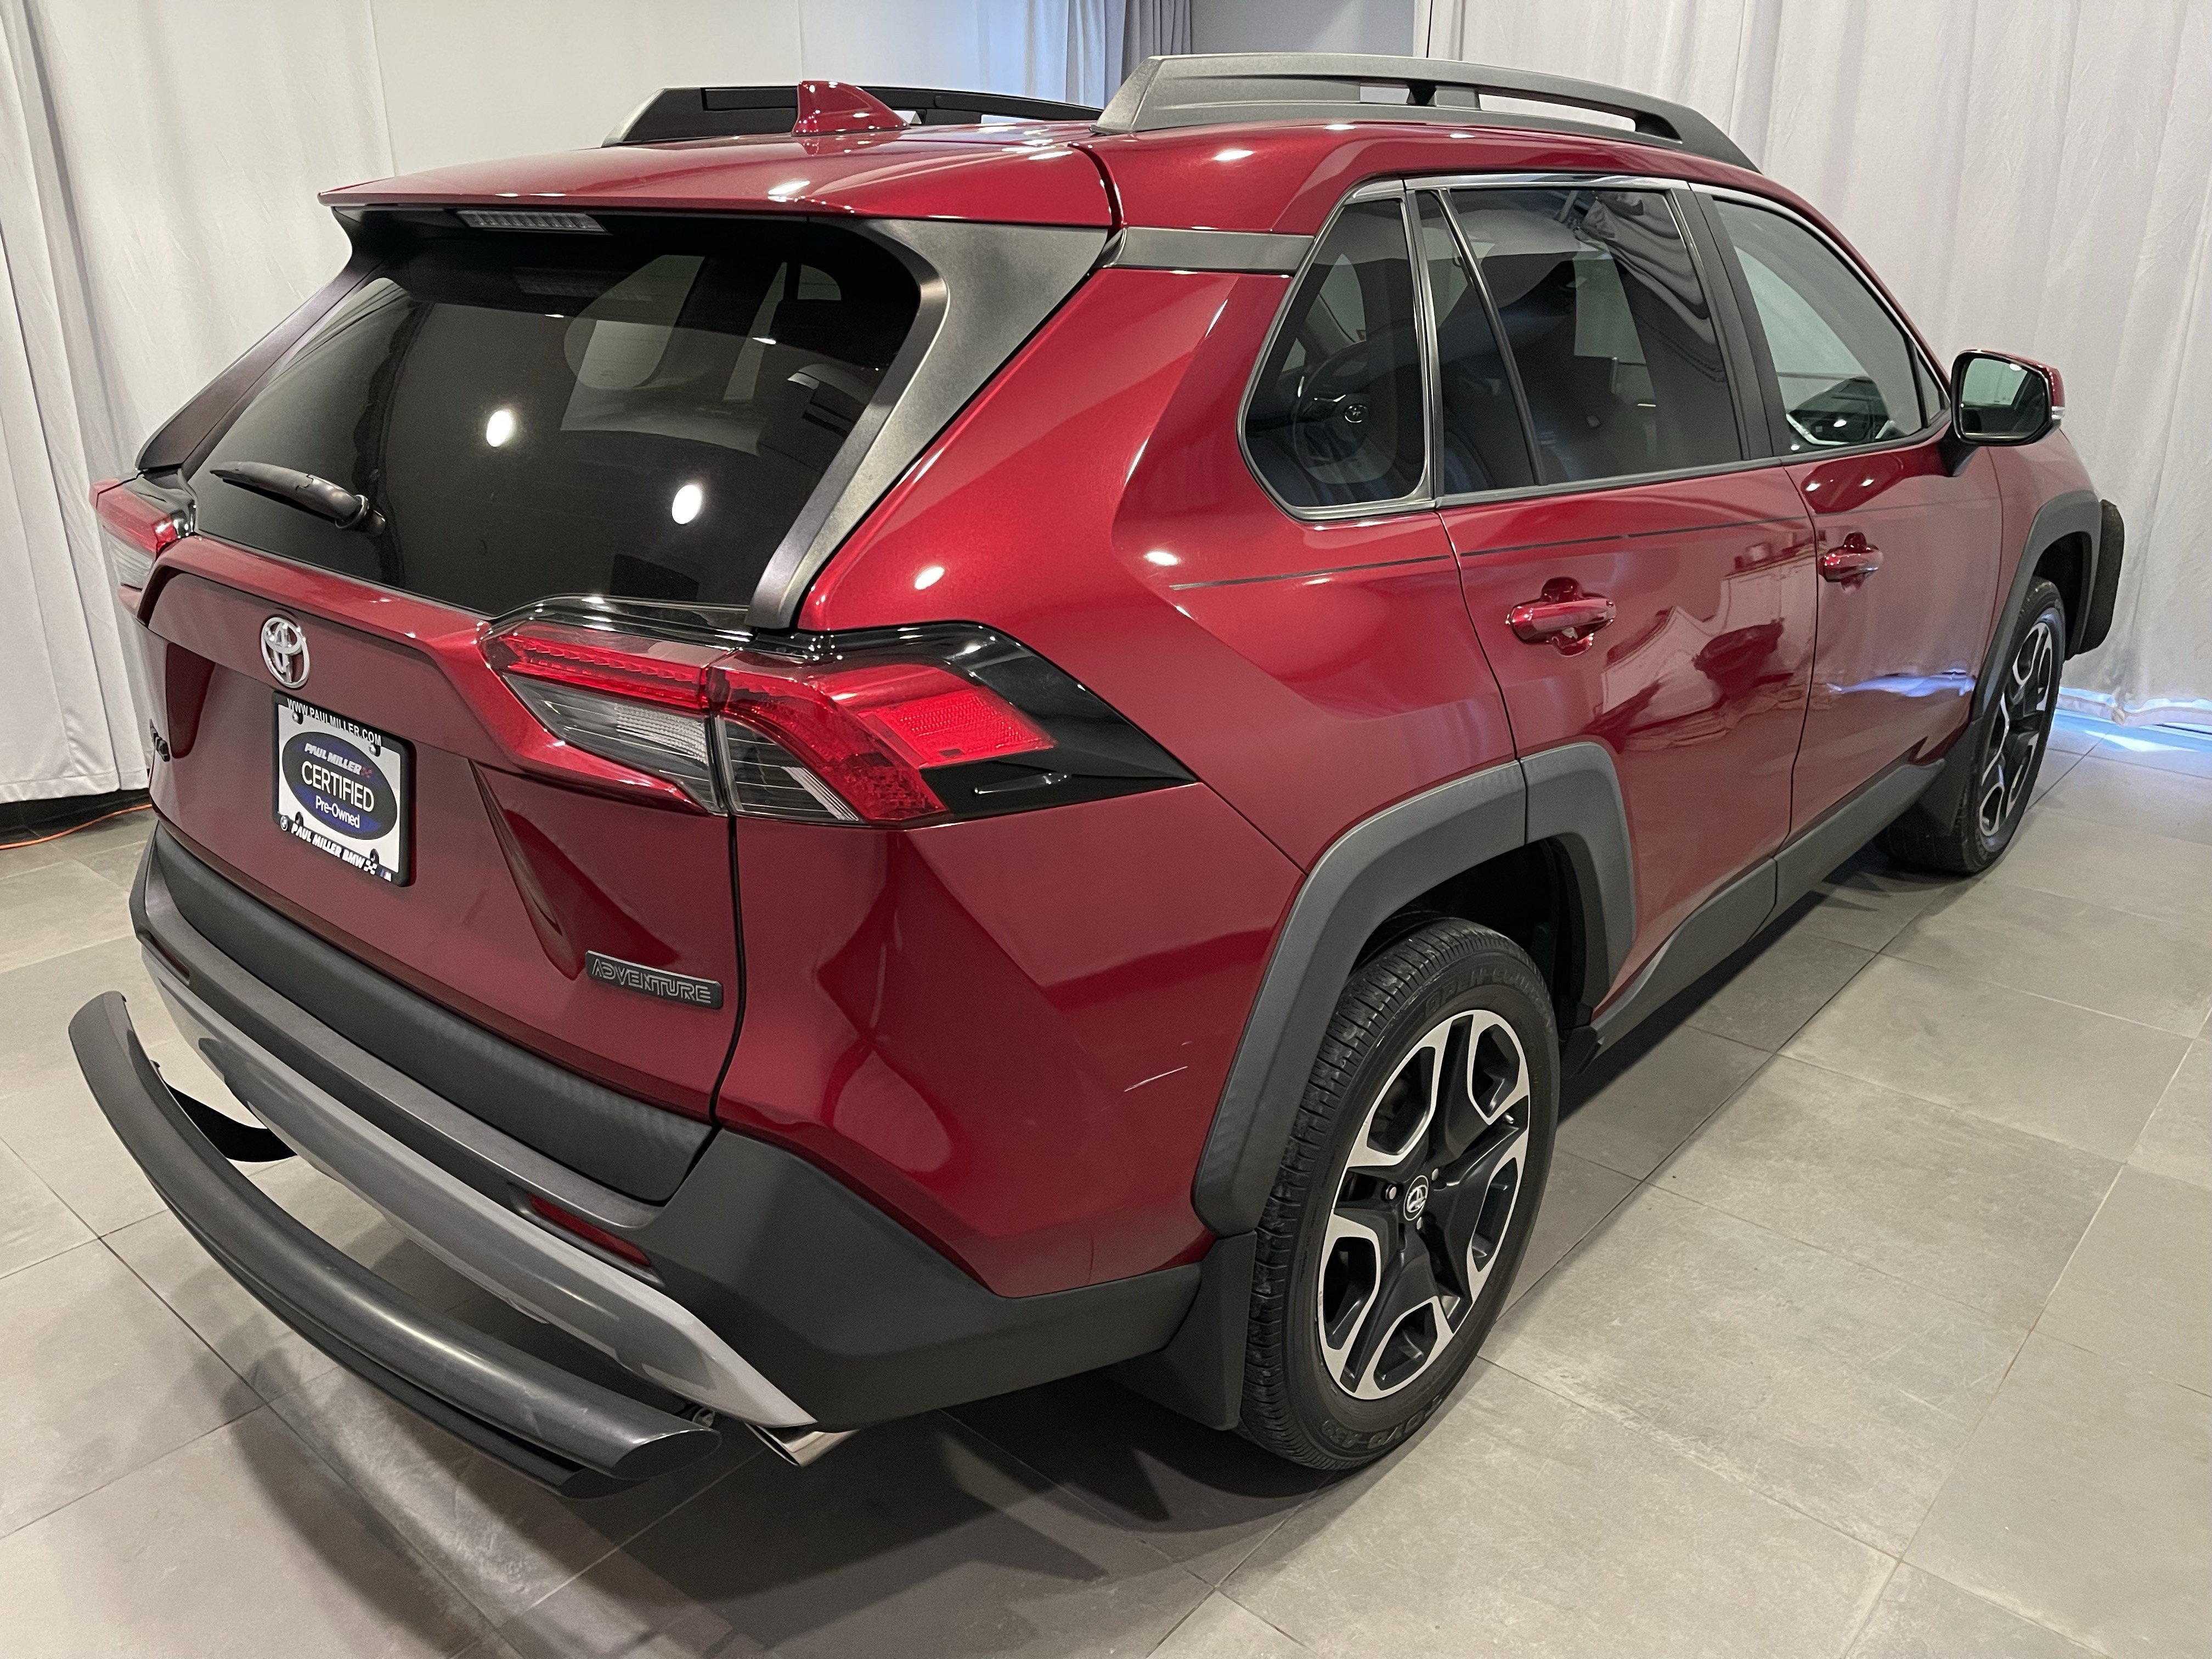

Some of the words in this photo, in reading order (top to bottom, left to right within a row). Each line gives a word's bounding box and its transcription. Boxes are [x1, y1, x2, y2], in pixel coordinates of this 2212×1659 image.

[287, 698, 381, 746] WWW.PAULMILLER.COM
[304, 743, 327, 760] PAUL
[328, 754, 362, 775] MILLER
[301, 761, 375, 812] CERTIFIED
[315, 795, 360, 829] Pre-Owned
[291, 823, 312, 843] PAUL
[312, 834, 342, 857] MILLER
[342, 849, 365, 870] BMW
[591, 958, 711, 1004] ADVENTURE
